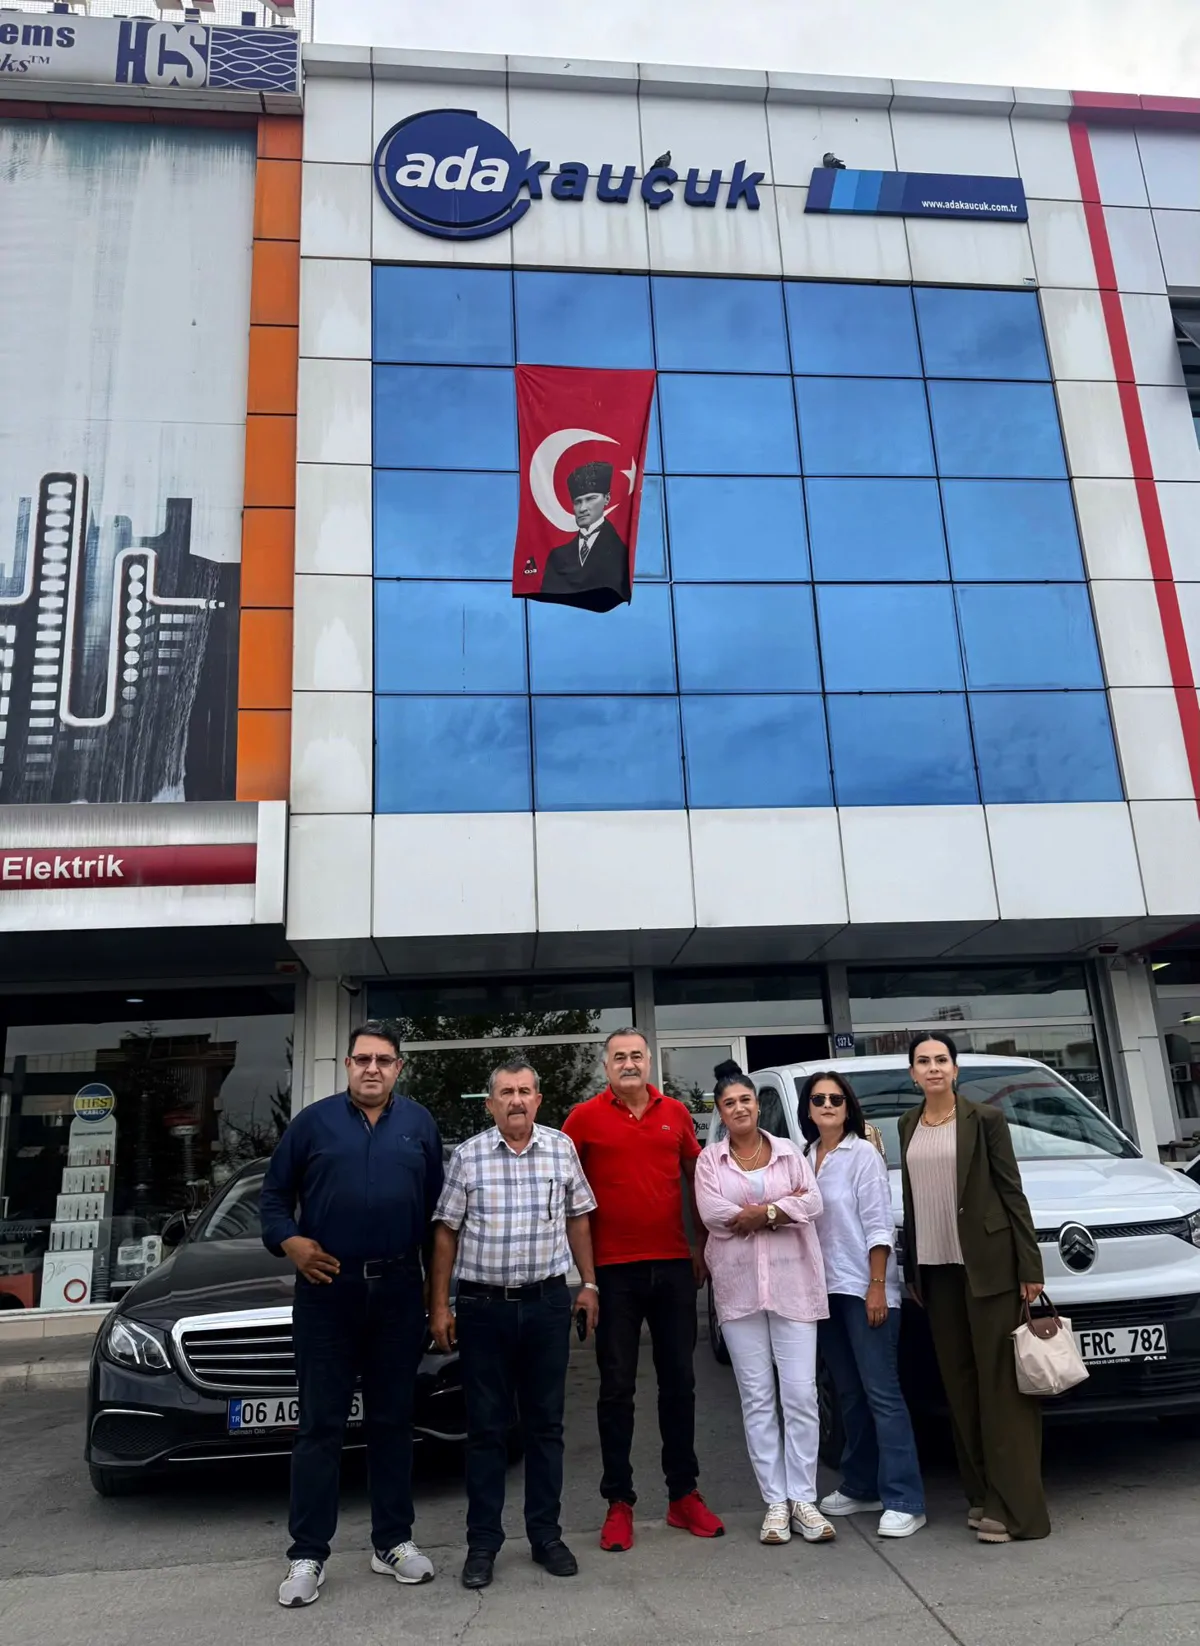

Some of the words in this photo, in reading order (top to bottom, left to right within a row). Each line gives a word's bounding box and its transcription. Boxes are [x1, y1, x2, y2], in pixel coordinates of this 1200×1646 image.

[115, 20, 208, 88] HCS
[395, 146, 509, 193] ada
[515, 148, 765, 210] kauçuk
[921, 200, 1018, 213] www.adakaucuk.com.tr
[2, 855, 124, 881] Elektrik
[82, 1098, 108, 1109] HES
[1080, 1332, 1116, 1357] FRC
[1128, 1328, 1165, 1353] 782
[231, 1415, 241, 1423] TR
[242, 1401, 267, 1424] 06
